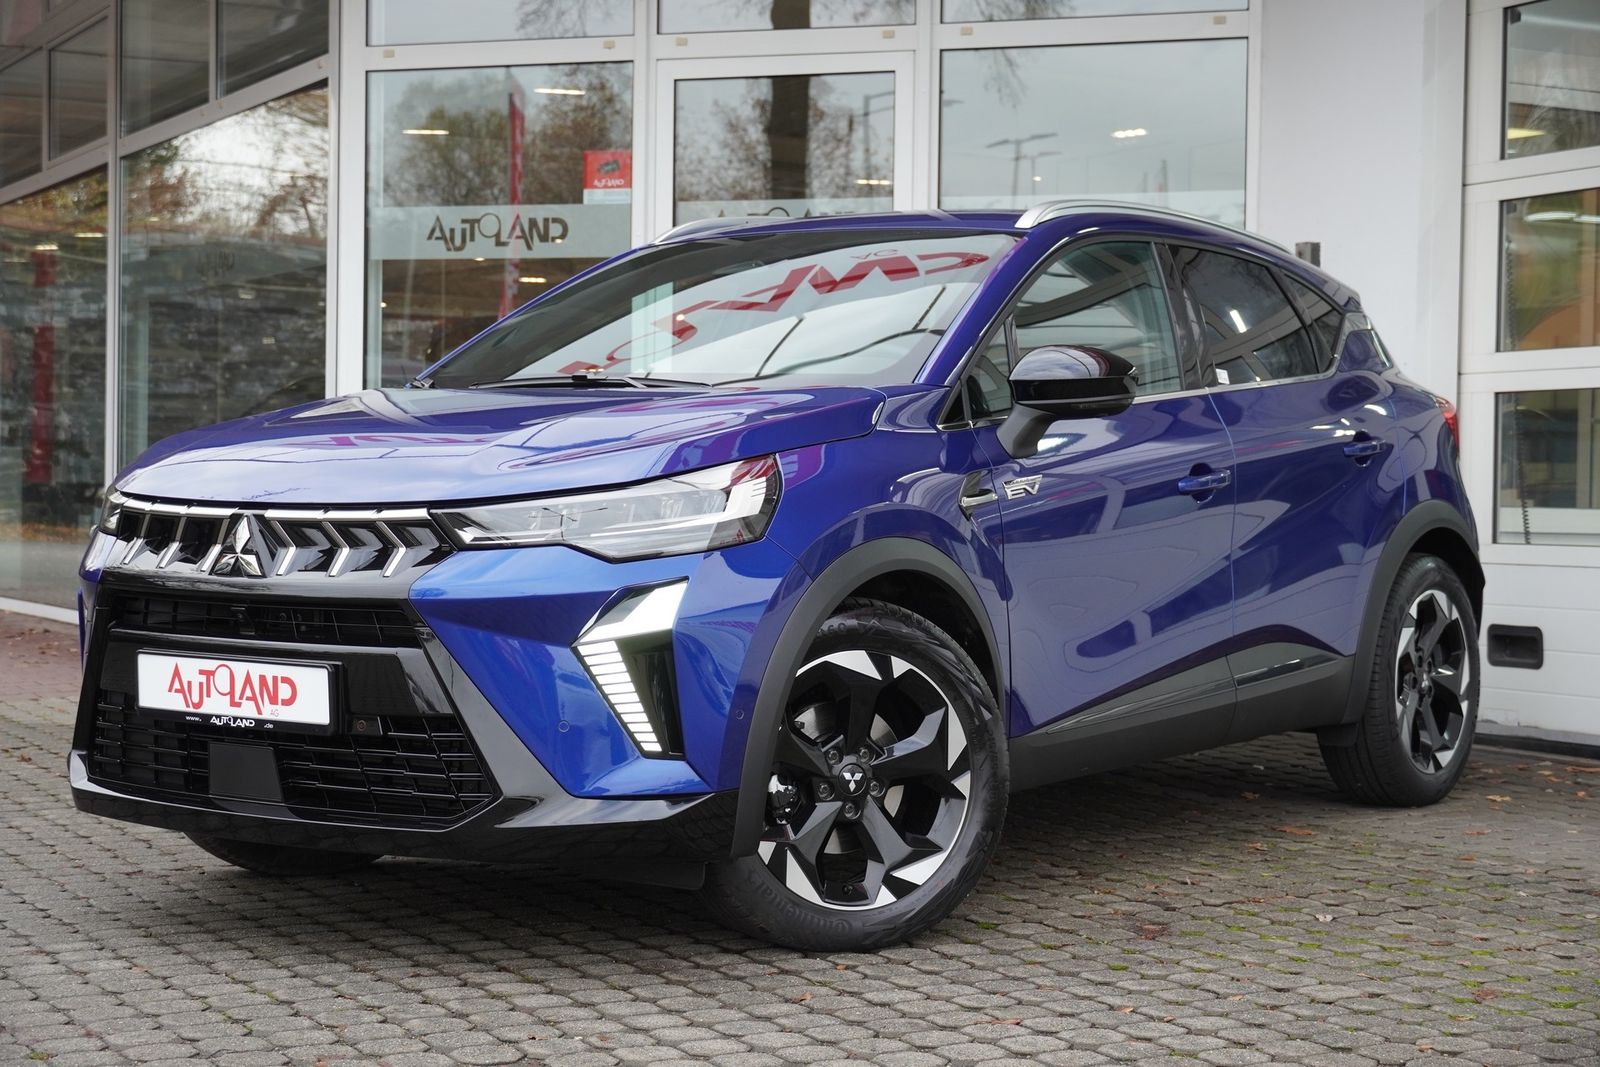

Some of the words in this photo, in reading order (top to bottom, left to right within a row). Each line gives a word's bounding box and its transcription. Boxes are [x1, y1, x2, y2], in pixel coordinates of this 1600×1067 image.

[427, 212, 569, 251] AUTOLAND
[167, 662, 298, 716] AUTOLAND
[210, 715, 256, 728] AUTOLAND
